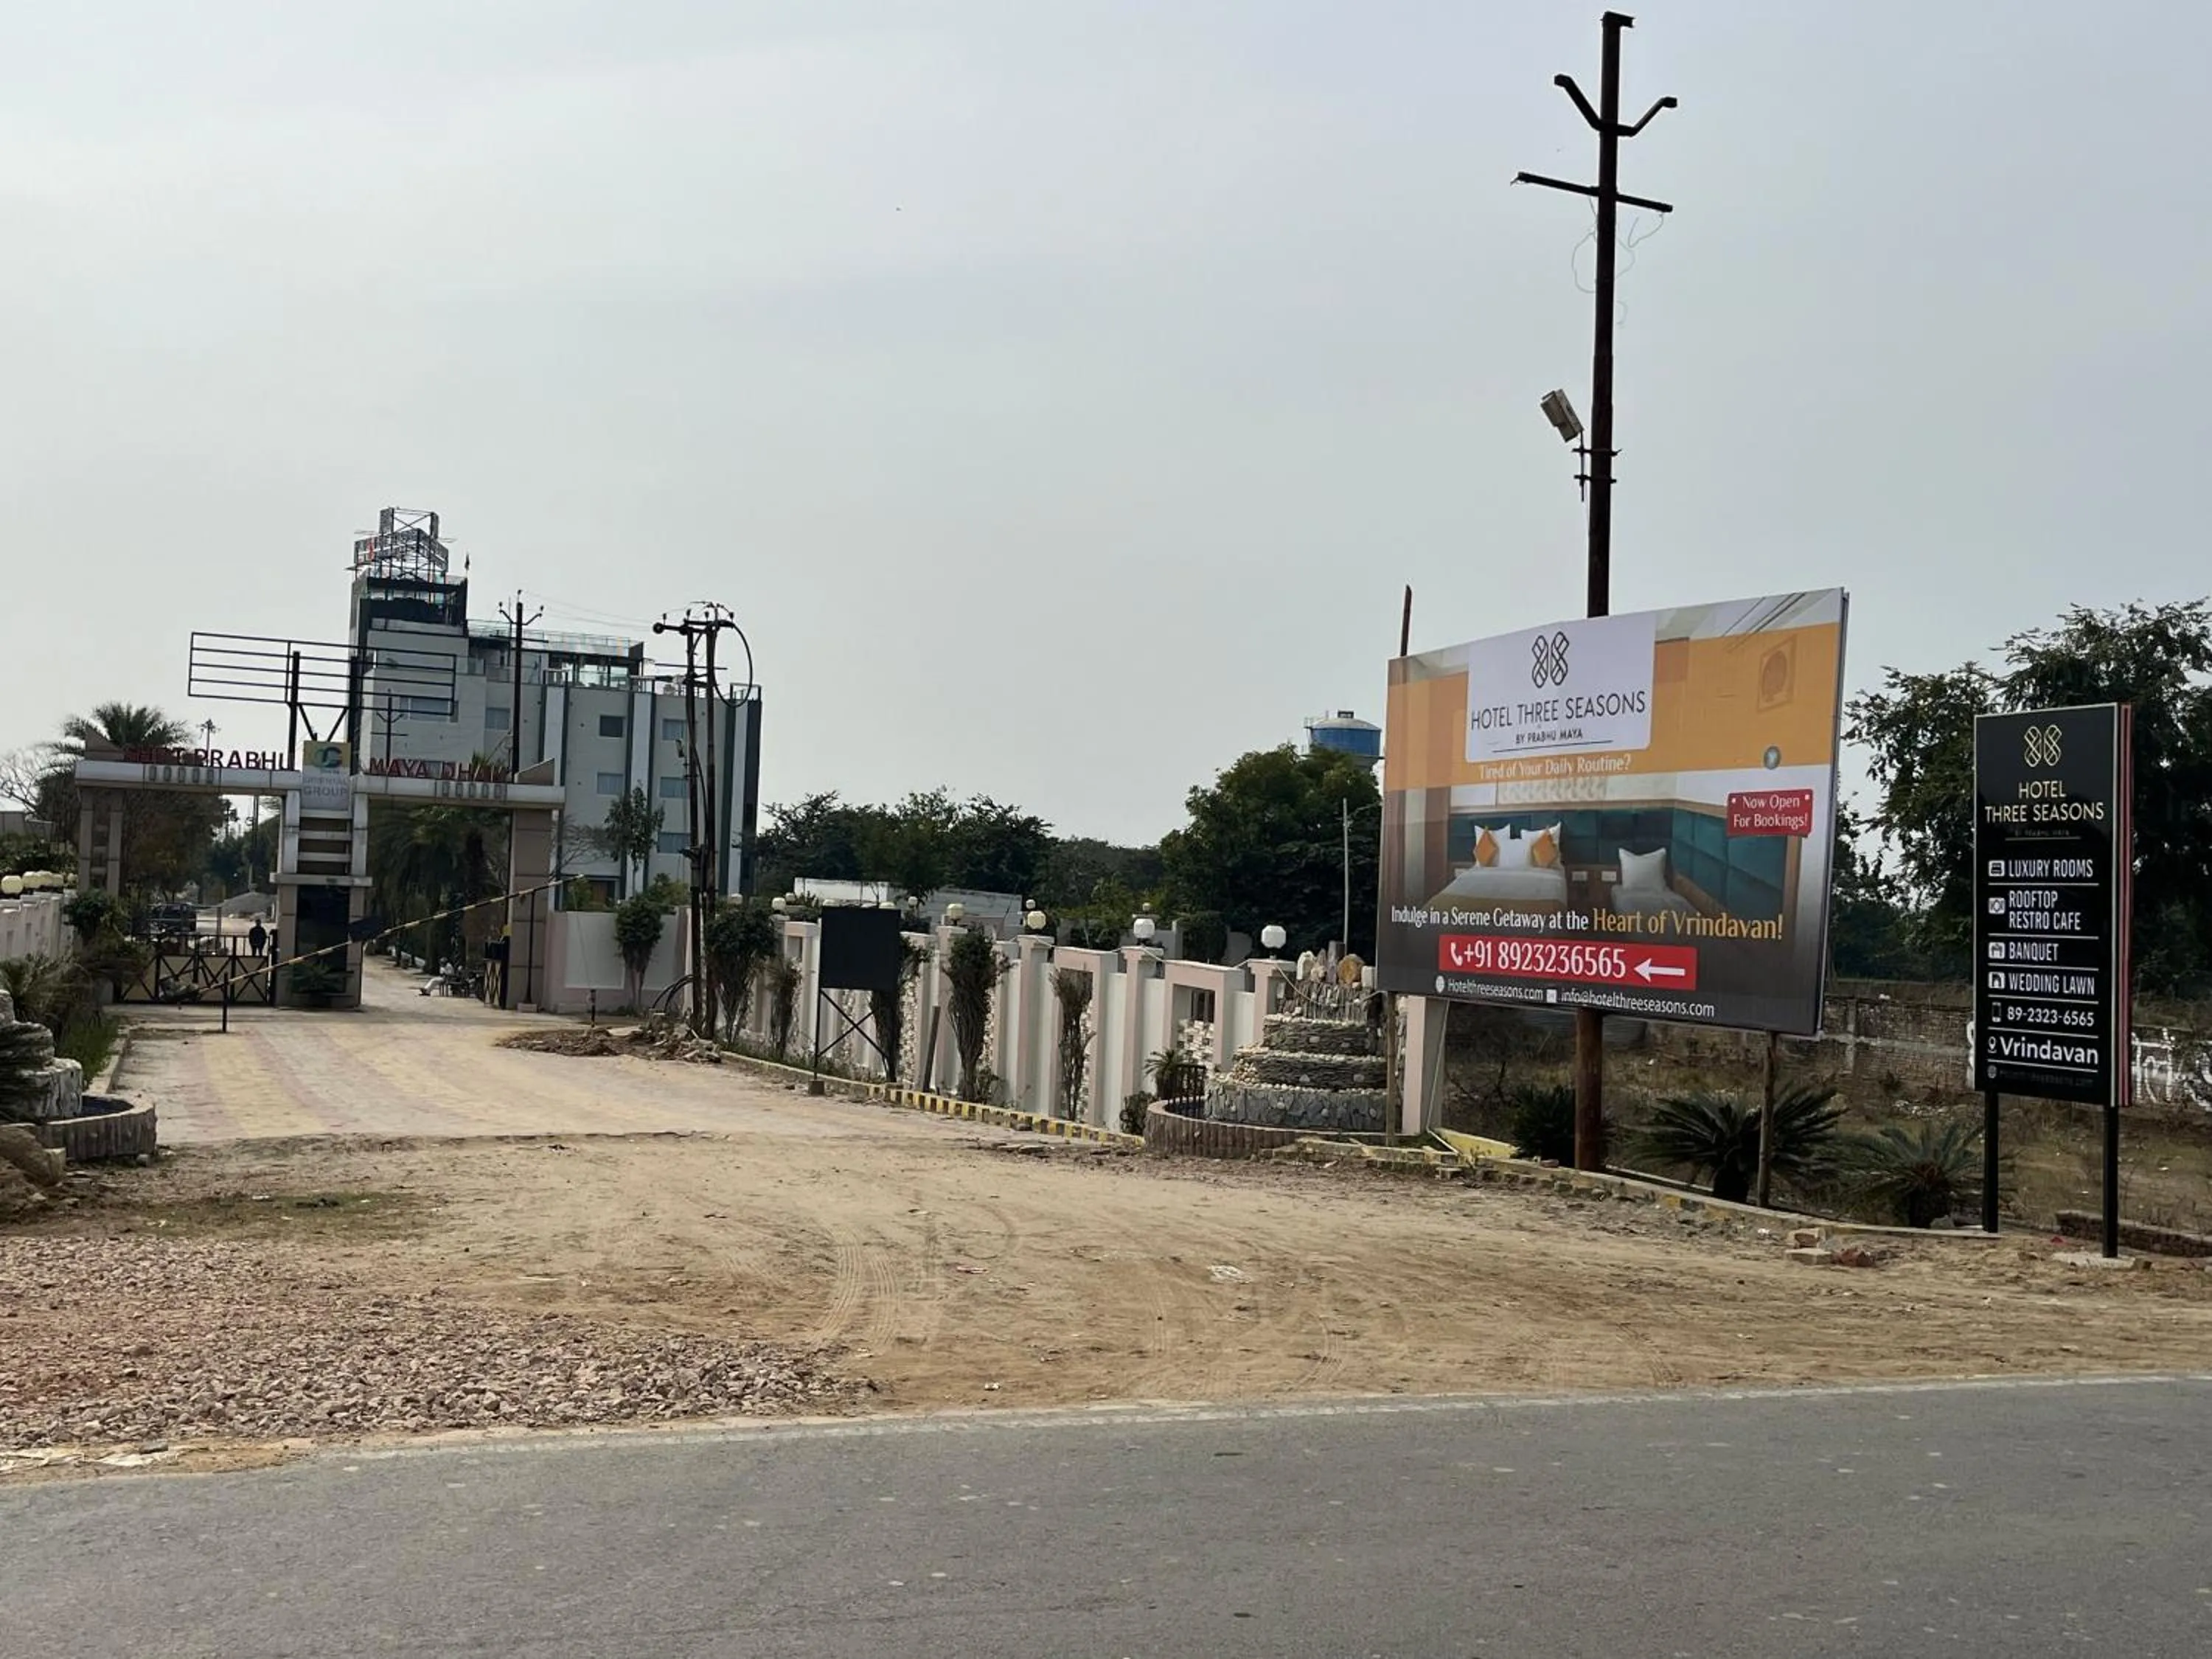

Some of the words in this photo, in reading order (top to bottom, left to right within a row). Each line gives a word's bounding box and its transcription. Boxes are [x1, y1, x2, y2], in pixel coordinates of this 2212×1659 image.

[1471, 706, 1513, 731] HOTEL
[1517, 699, 1559, 726] THREE
[1565, 691, 1646, 720] SEASONS
[1515, 734, 1526, 745] BY
[1528, 731, 1557, 743] PRABHU
[1560, 728, 1584, 740] MAYA
[370, 757, 428, 779] MAYA
[1479, 764, 1504, 780] Tired
[1506, 762, 1517, 778] of
[1517, 760, 1542, 777] Your
[1545, 757, 1573, 776] Daily
[1577, 753, 1632, 773] Routine?
[303, 786, 348, 797] GROUP
[2018, 781, 2067, 799] HOTEL
[1742, 796, 1767, 809] Now
[1770, 794, 1800, 811] Open
[1985, 804, 2028, 823] THREE
[2033, 801, 2104, 821] SEASONS
[1733, 813, 1752, 827] For
[1754, 811, 1808, 830] Bookings!
[2008, 859, 2051, 878] LUXURY
[2053, 858, 2093, 878] ROOMS
[2008, 890, 2058, 909] ROOFTOP
[1391, 905, 1428, 928] Indulge
[1430, 905, 1440, 925] in
[1442, 911, 1449, 925] a
[1451, 906, 1490, 927] Serene
[1493, 908, 1545, 933] Getaway
[1549, 913, 1563, 930] at
[1566, 910, 1589, 930] the
[1593, 908, 1643, 933] Heart
[1648, 909, 1667, 935] of
[1672, 910, 1784, 941] Vrindavan!
[2008, 911, 2050, 930] RESTRO
[2053, 911, 2081, 931] CAFE
[1464, 939, 1492, 969] +91
[1498, 941, 1626, 979] 8923236565
[2008, 941, 2059, 961] BANQUET
[2008, 973, 2059, 993] WEDDING
[2062, 975, 2095, 995] LAWN
[1447, 978, 1544, 1001] Hotelthreeseasons.com
[1560, 987, 1715, 1018] info@hotelthreeseasons.com
[2007, 1006, 2095, 1027] 89-2323-6565
[1999, 1035, 2099, 1065] Vrindavan
